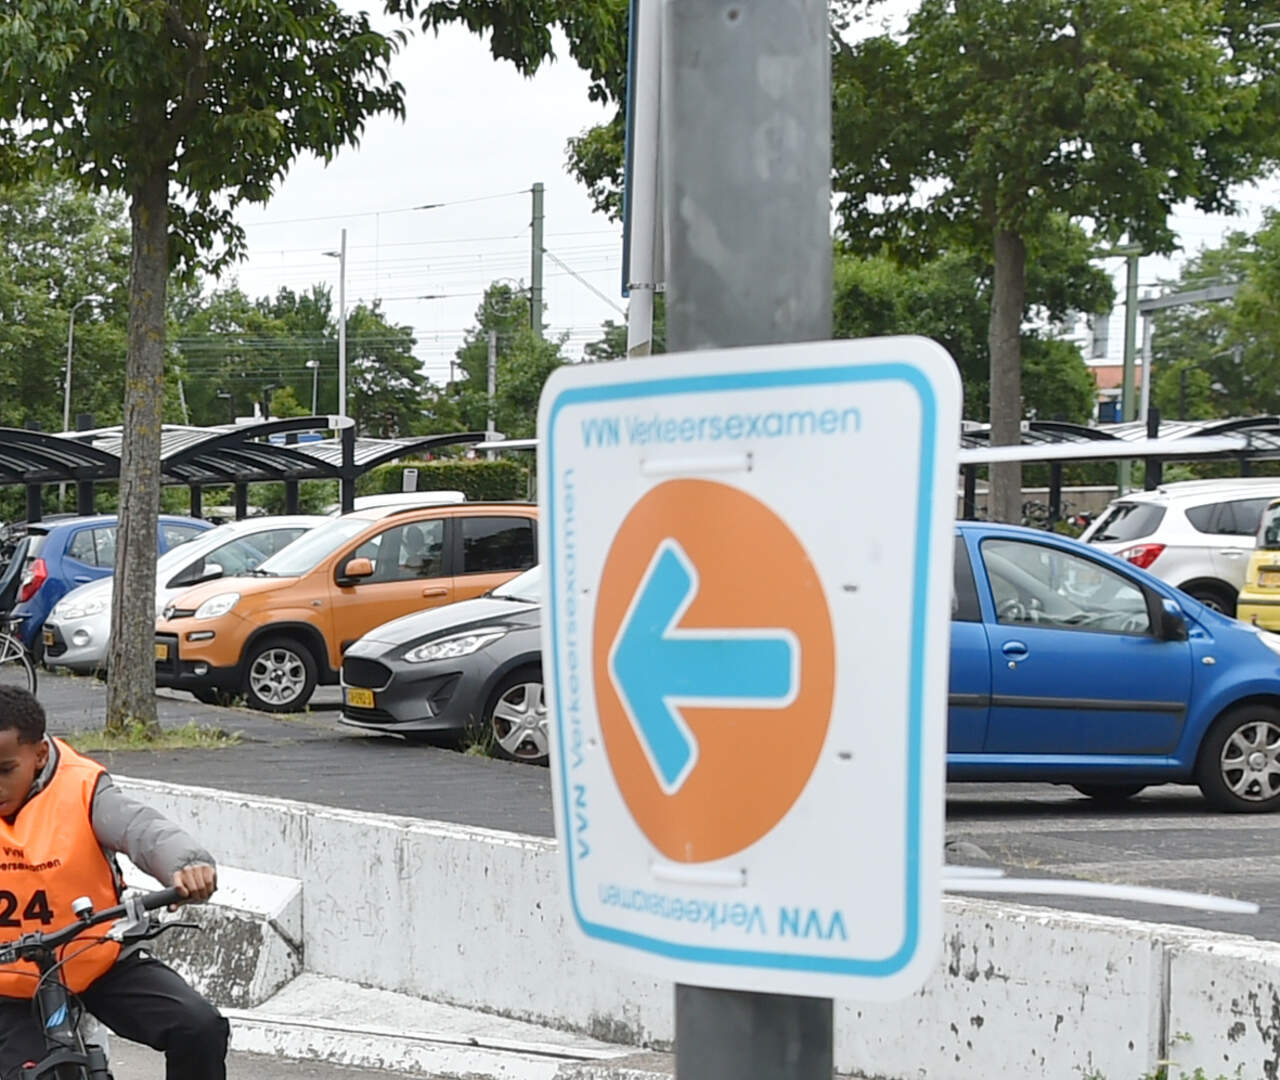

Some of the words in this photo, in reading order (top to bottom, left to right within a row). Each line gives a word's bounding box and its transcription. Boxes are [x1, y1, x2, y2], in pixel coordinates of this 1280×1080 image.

[580, 415, 621, 449] VVN
[625, 406, 862, 445] Verkeersexamen
[563, 468, 585, 769] Verkeersexamen
[574, 783, 592, 860] VVN
[779, 906, 848, 941] VVN
